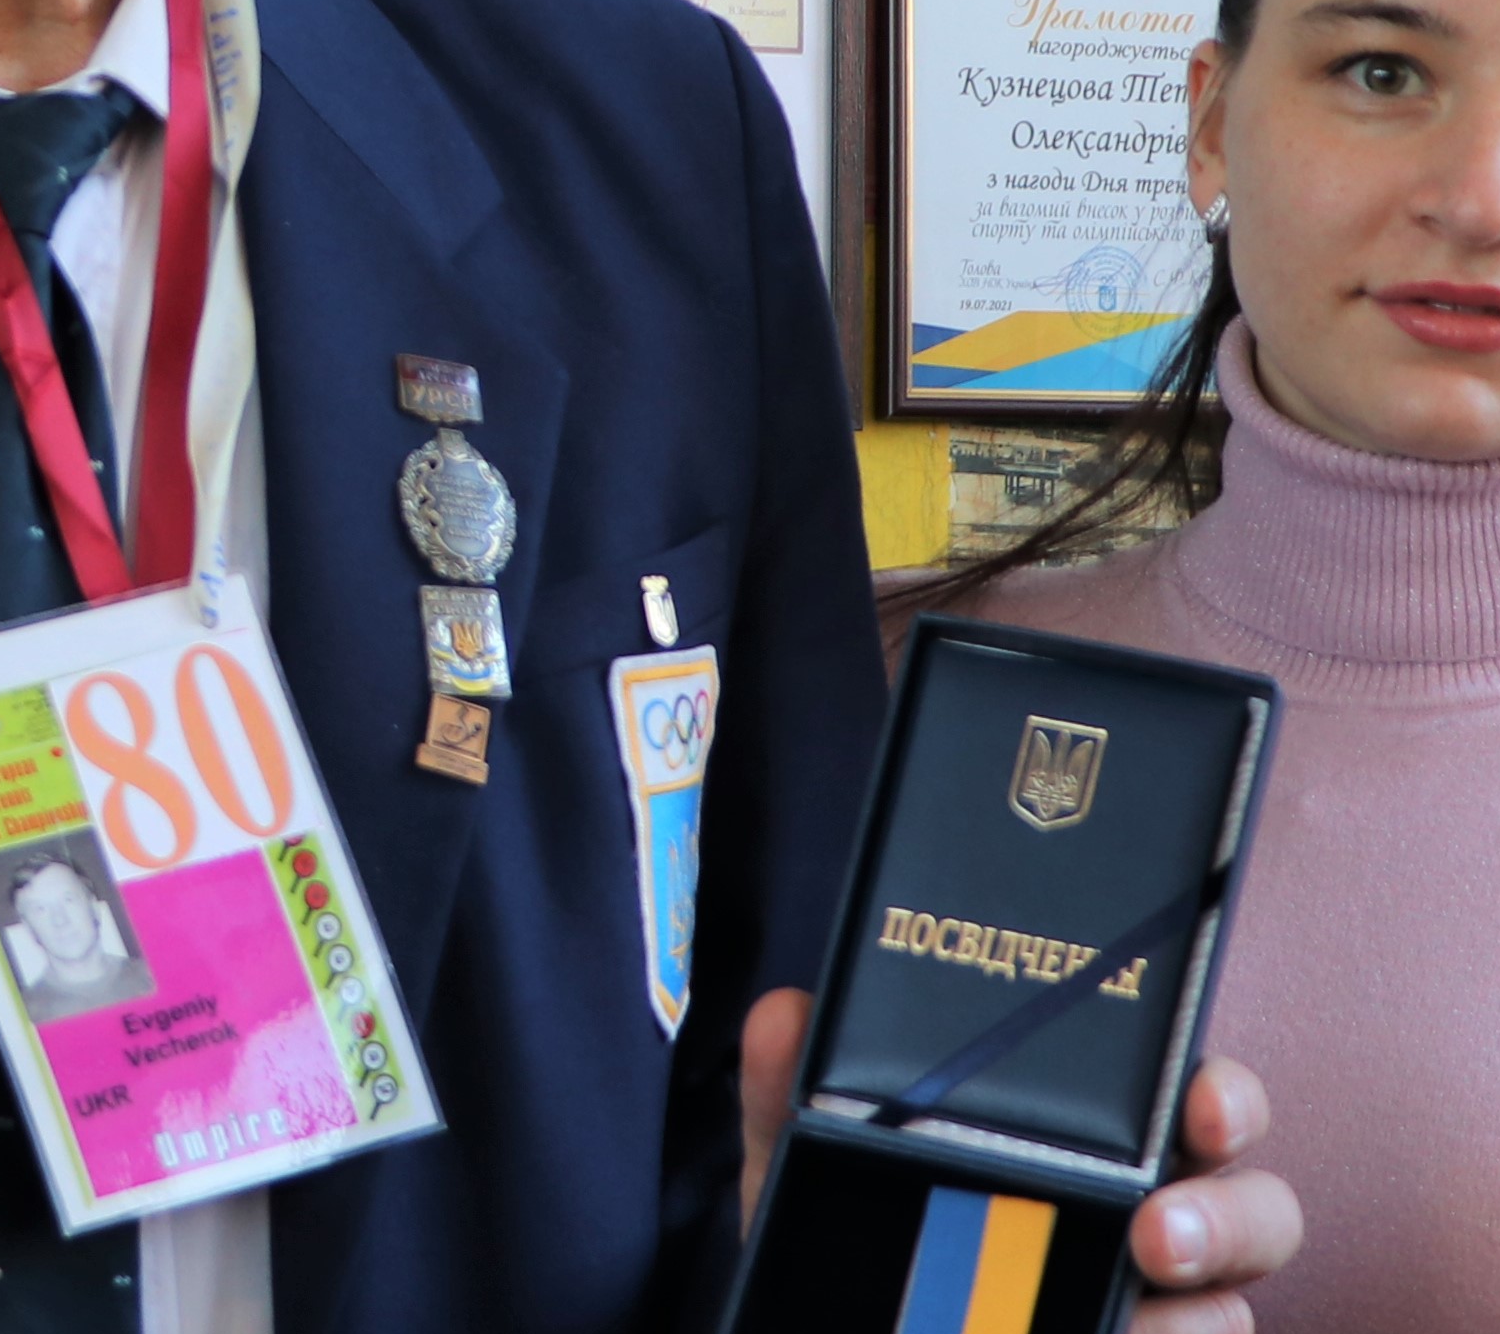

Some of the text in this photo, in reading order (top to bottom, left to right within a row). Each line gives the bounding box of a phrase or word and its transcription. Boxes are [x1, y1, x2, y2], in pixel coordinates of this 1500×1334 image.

[958, 67, 1114, 107] Кузнецова
[986, 167, 1129, 194] з нагоди Дня
[959, 298, 1013, 313] 19.07.2021
[65, 642, 296, 871] 80
[122, 993, 219, 1037] Evgeniy
[125, 1021, 240, 1068] Vecherok
[74, 1083, 134, 1120] UKR
[154, 1105, 289, 1169] Umpire
